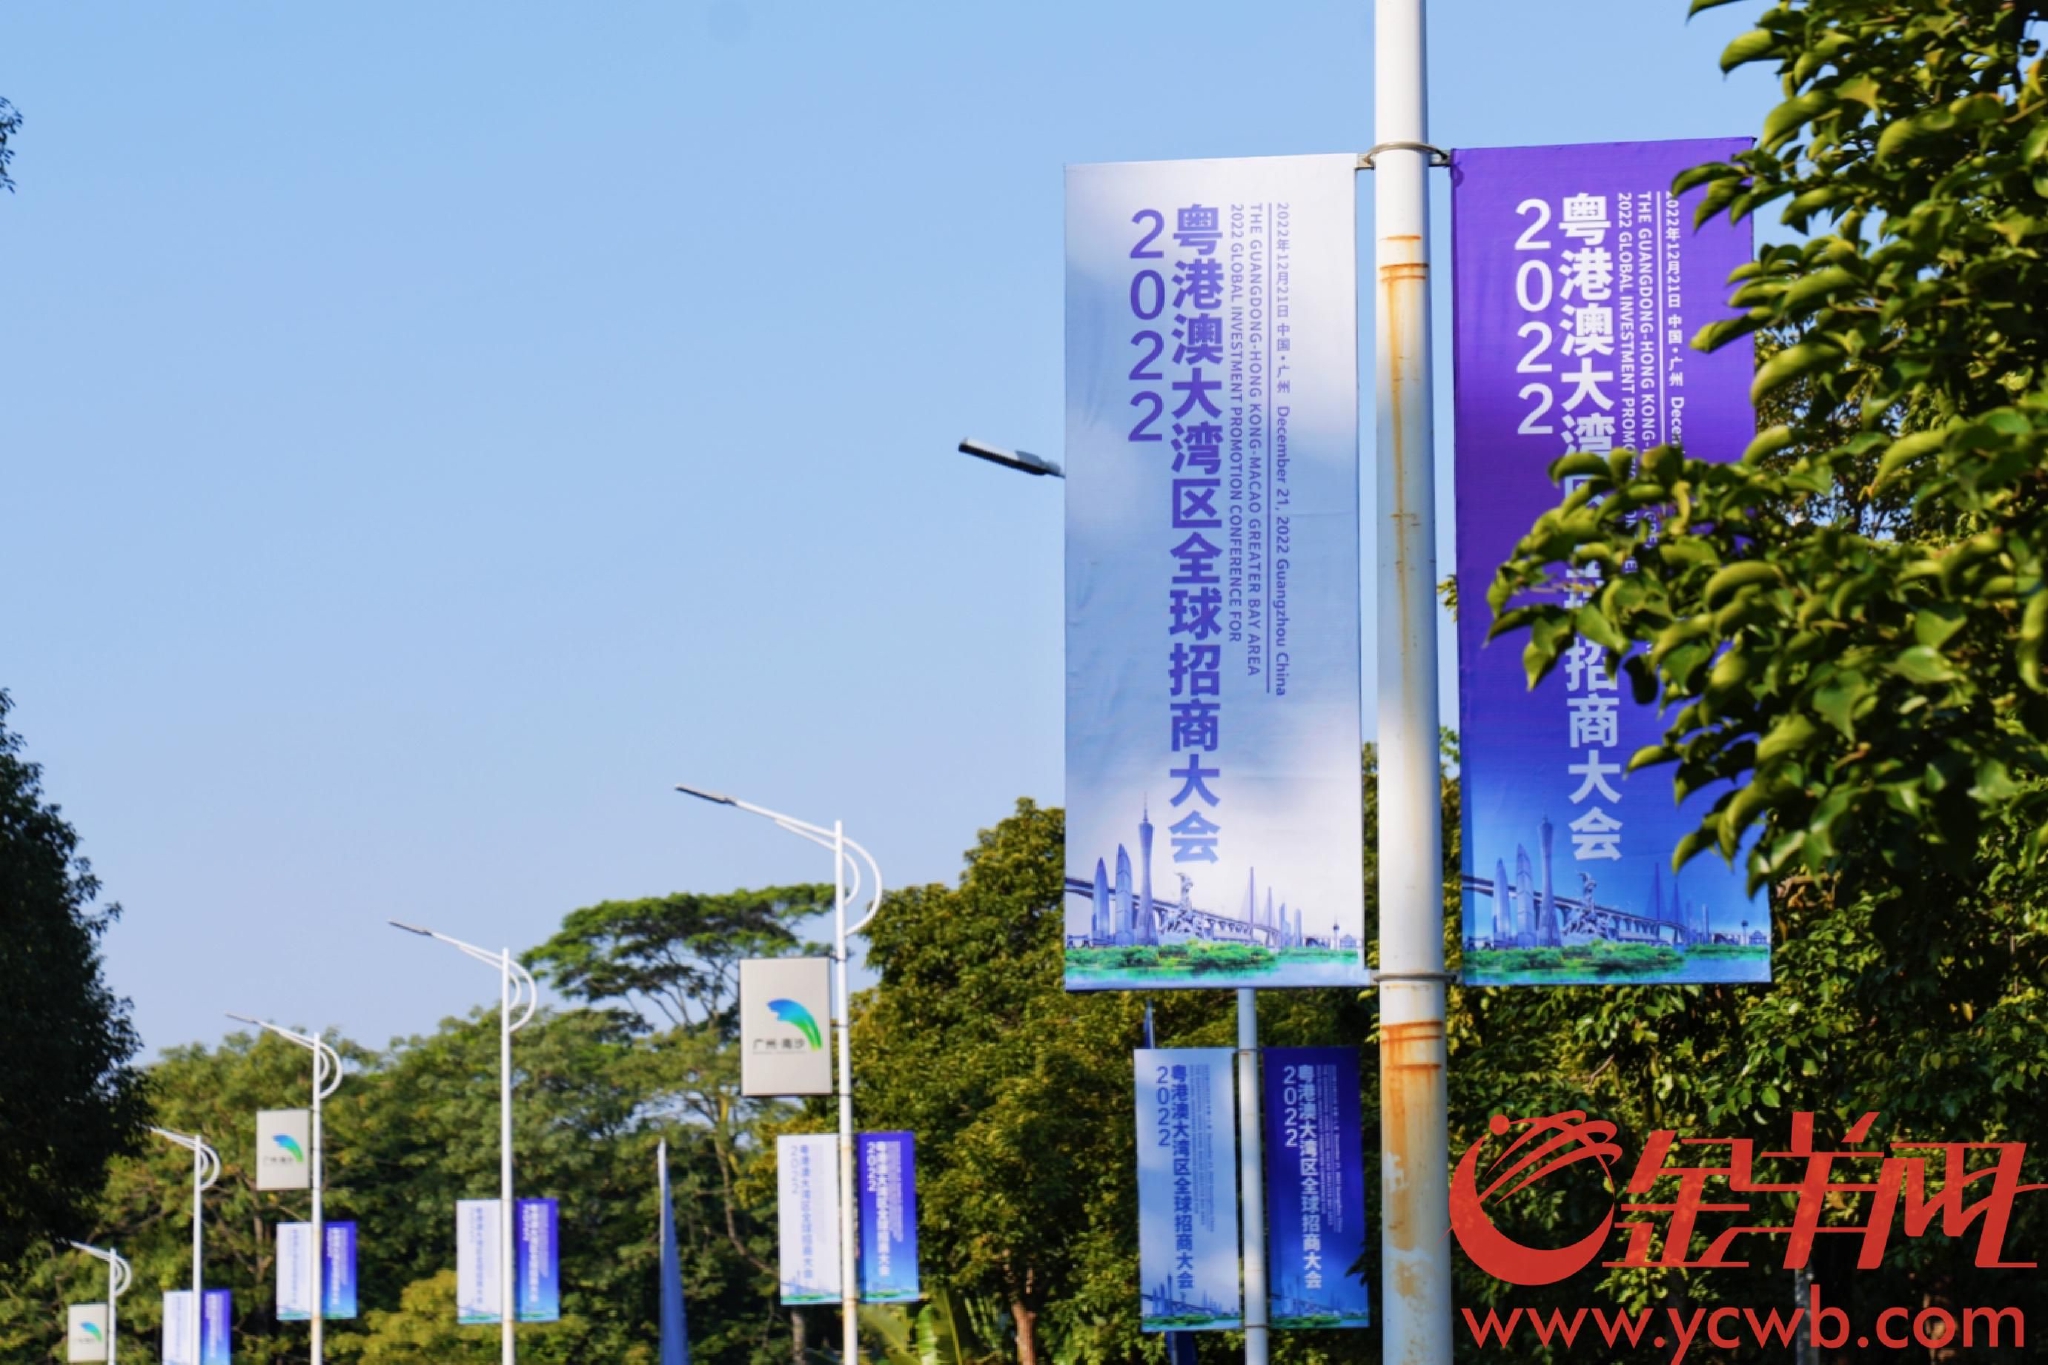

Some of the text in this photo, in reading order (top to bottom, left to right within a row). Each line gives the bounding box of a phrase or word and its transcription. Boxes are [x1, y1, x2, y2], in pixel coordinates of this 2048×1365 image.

[1618, 192, 1633, 229] 2022
[1638, 191, 1652, 224] THE
[1619, 231, 1634, 293] GLOBAL
[1128, 209, 1165, 443] 2022
[1514, 198, 1554, 435] 2022
[1619, 295, 1636, 394] INVESTMENT
[1639, 227, 1655, 389] GUANGDONG-HONG
[1228, 203, 1244, 643] 2022 GLOBAL INVESTMENT PROMOTION CONFERENCE FOR
[1247, 202, 1264, 677] THE GUANGDONG-HONG KONG-MACAO GREATER BAY AREA
[1277, 405, 1291, 484] December
[1169, 203, 1223, 864] 粤港澳大湾区全球招商大会
[1275, 487, 1291, 512] 21,
[1276, 515, 1290, 554] 2022
[1272, 558, 1290, 647] Guangzhou
[1276, 651, 1290, 697] China
[1156, 1065, 1171, 1147] 2022
[1283, 1065, 1299, 1147] 2022
